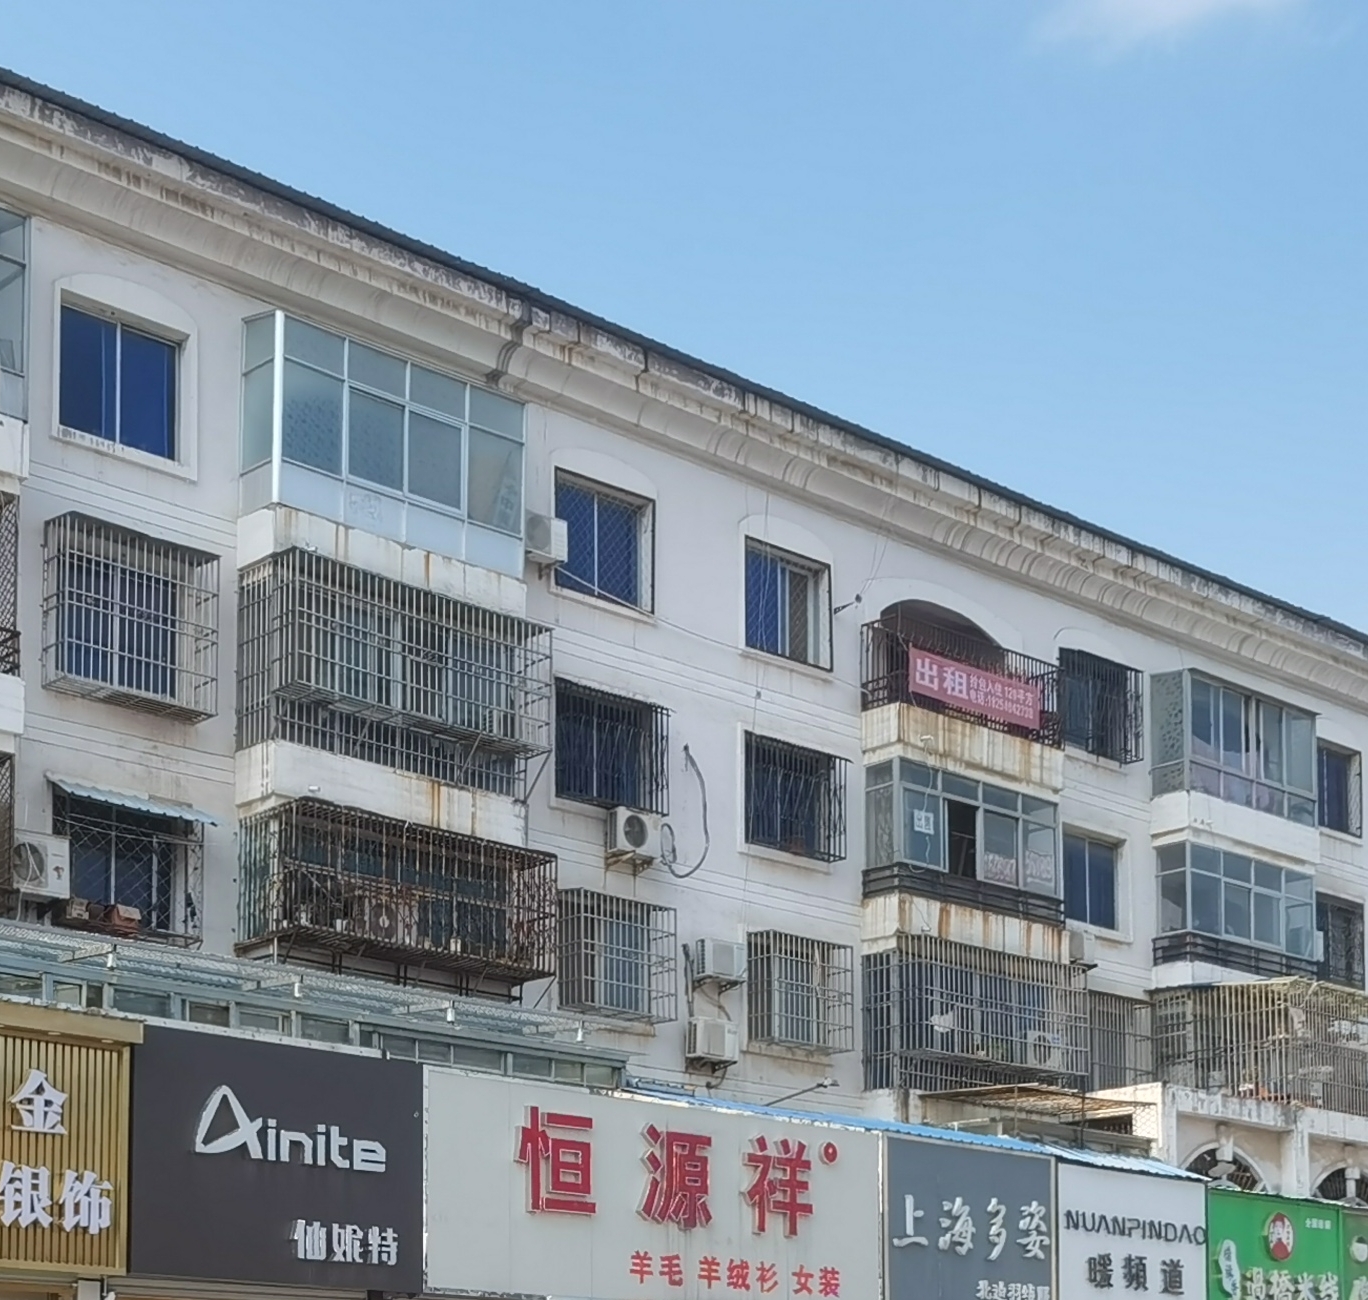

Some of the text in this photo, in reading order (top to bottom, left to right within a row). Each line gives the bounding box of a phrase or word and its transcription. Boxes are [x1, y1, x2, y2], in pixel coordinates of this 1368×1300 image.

[915, 657, 969, 700] 出租
[195, 1085, 386, 1172] Ainite
[514, 1105, 814, 1238] 恒源祥
[292, 1219, 399, 1266] 仙妮特
[893, 1194, 1050, 1261] 上海多姿
[1064, 1209, 1207, 1246] NUANPINDAO
[629, 1250, 841, 1298] 羊毛 羊绒衫 女装
